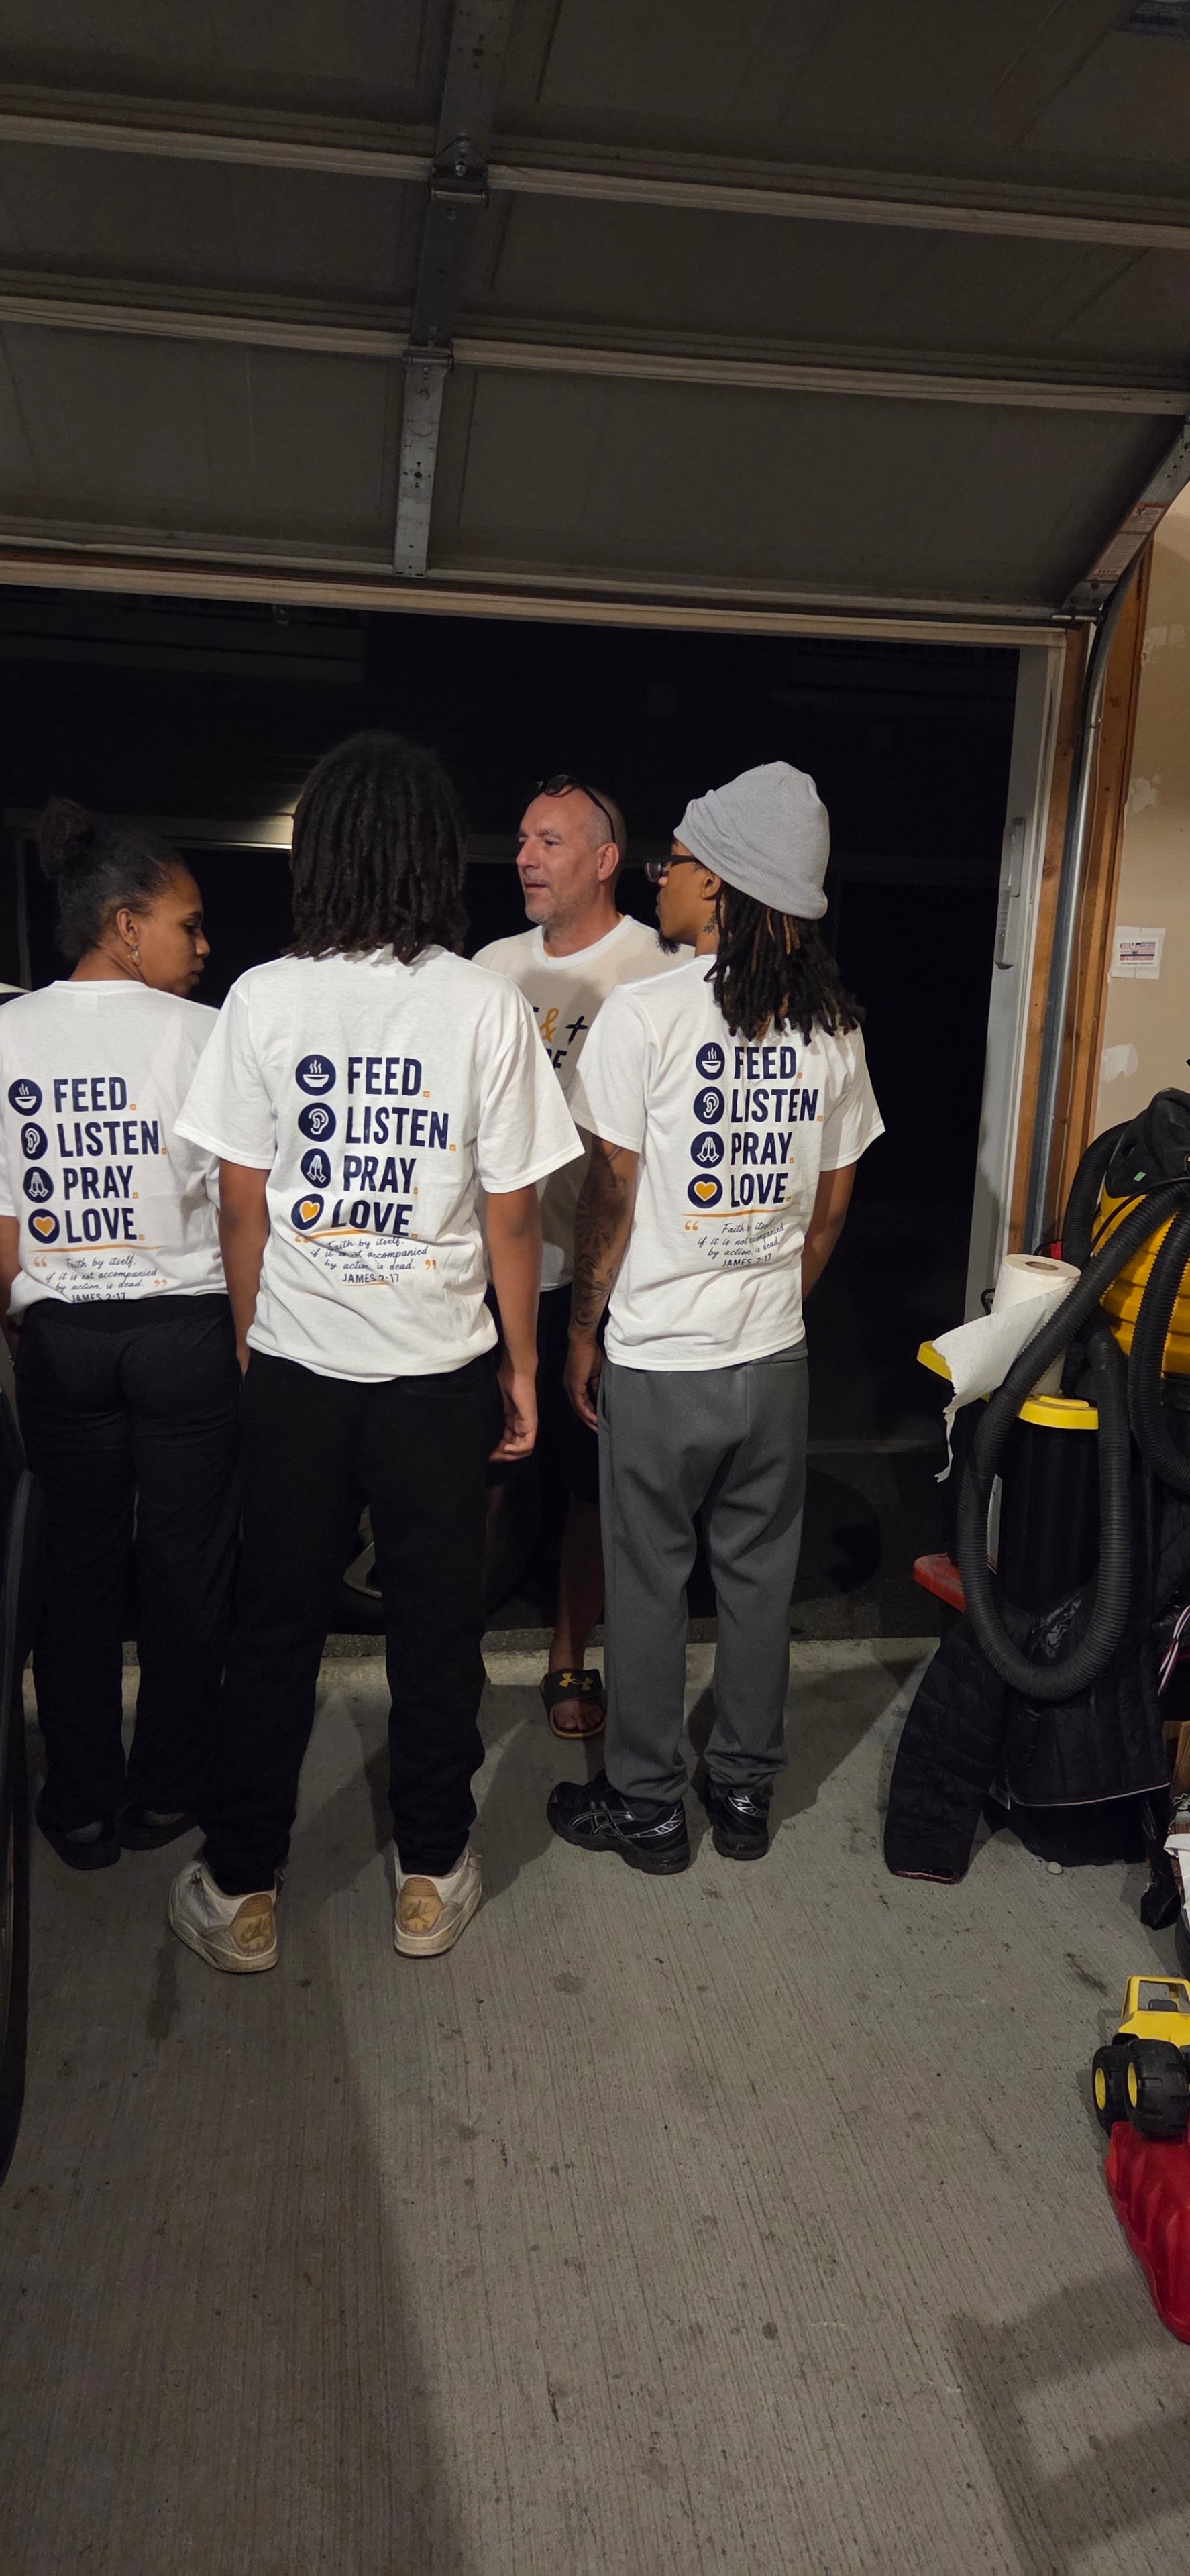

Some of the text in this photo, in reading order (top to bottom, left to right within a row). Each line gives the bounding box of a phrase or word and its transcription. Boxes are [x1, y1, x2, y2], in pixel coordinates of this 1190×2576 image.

[347, 1057, 430, 1098] FEED.
[734, 1046, 802, 1079] FEED.
[53, 1077, 136, 1113] FEED.
[731, 1088, 824, 1123] LISTEN.
[56, 1120, 167, 1157] LISTEN.
[345, 1106, 457, 1152] LISTEN.
[731, 1132, 794, 1165] PRAY.
[62, 1165, 138, 1200] PRAY.
[343, 1155, 419, 1195] PRAY.
[731, 1173, 792, 1208] LOVE.
[64, 1207, 145, 1243] LOVE.
[331, 1199, 419, 1239] LOVE.
[721, 1222, 744, 1234] Faith
[310, 1248, 321, 1257] if
[367, 1245, 429, 1262] accompanied
[326, 1239, 354, 1252] Faith
[359, 1238, 371, 1249] by
[698, 1236, 708, 1248] if
[710, 1237, 719, 1245] it
[735, 1236, 748, 1246] not
[708, 1246, 719, 1259] by
[45, 1267, 158, 1284] if it is not accompanied
[65, 1257, 87, 1268] Faith
[92, 1256, 104, 1269] by
[324, 1259, 337, 1270] by
[377, 1262, 384, 1270] is
[342, 1273, 376, 1283] JAMES
[55, 1282, 66, 1293] by
[106, 1281, 113, 1289] is
